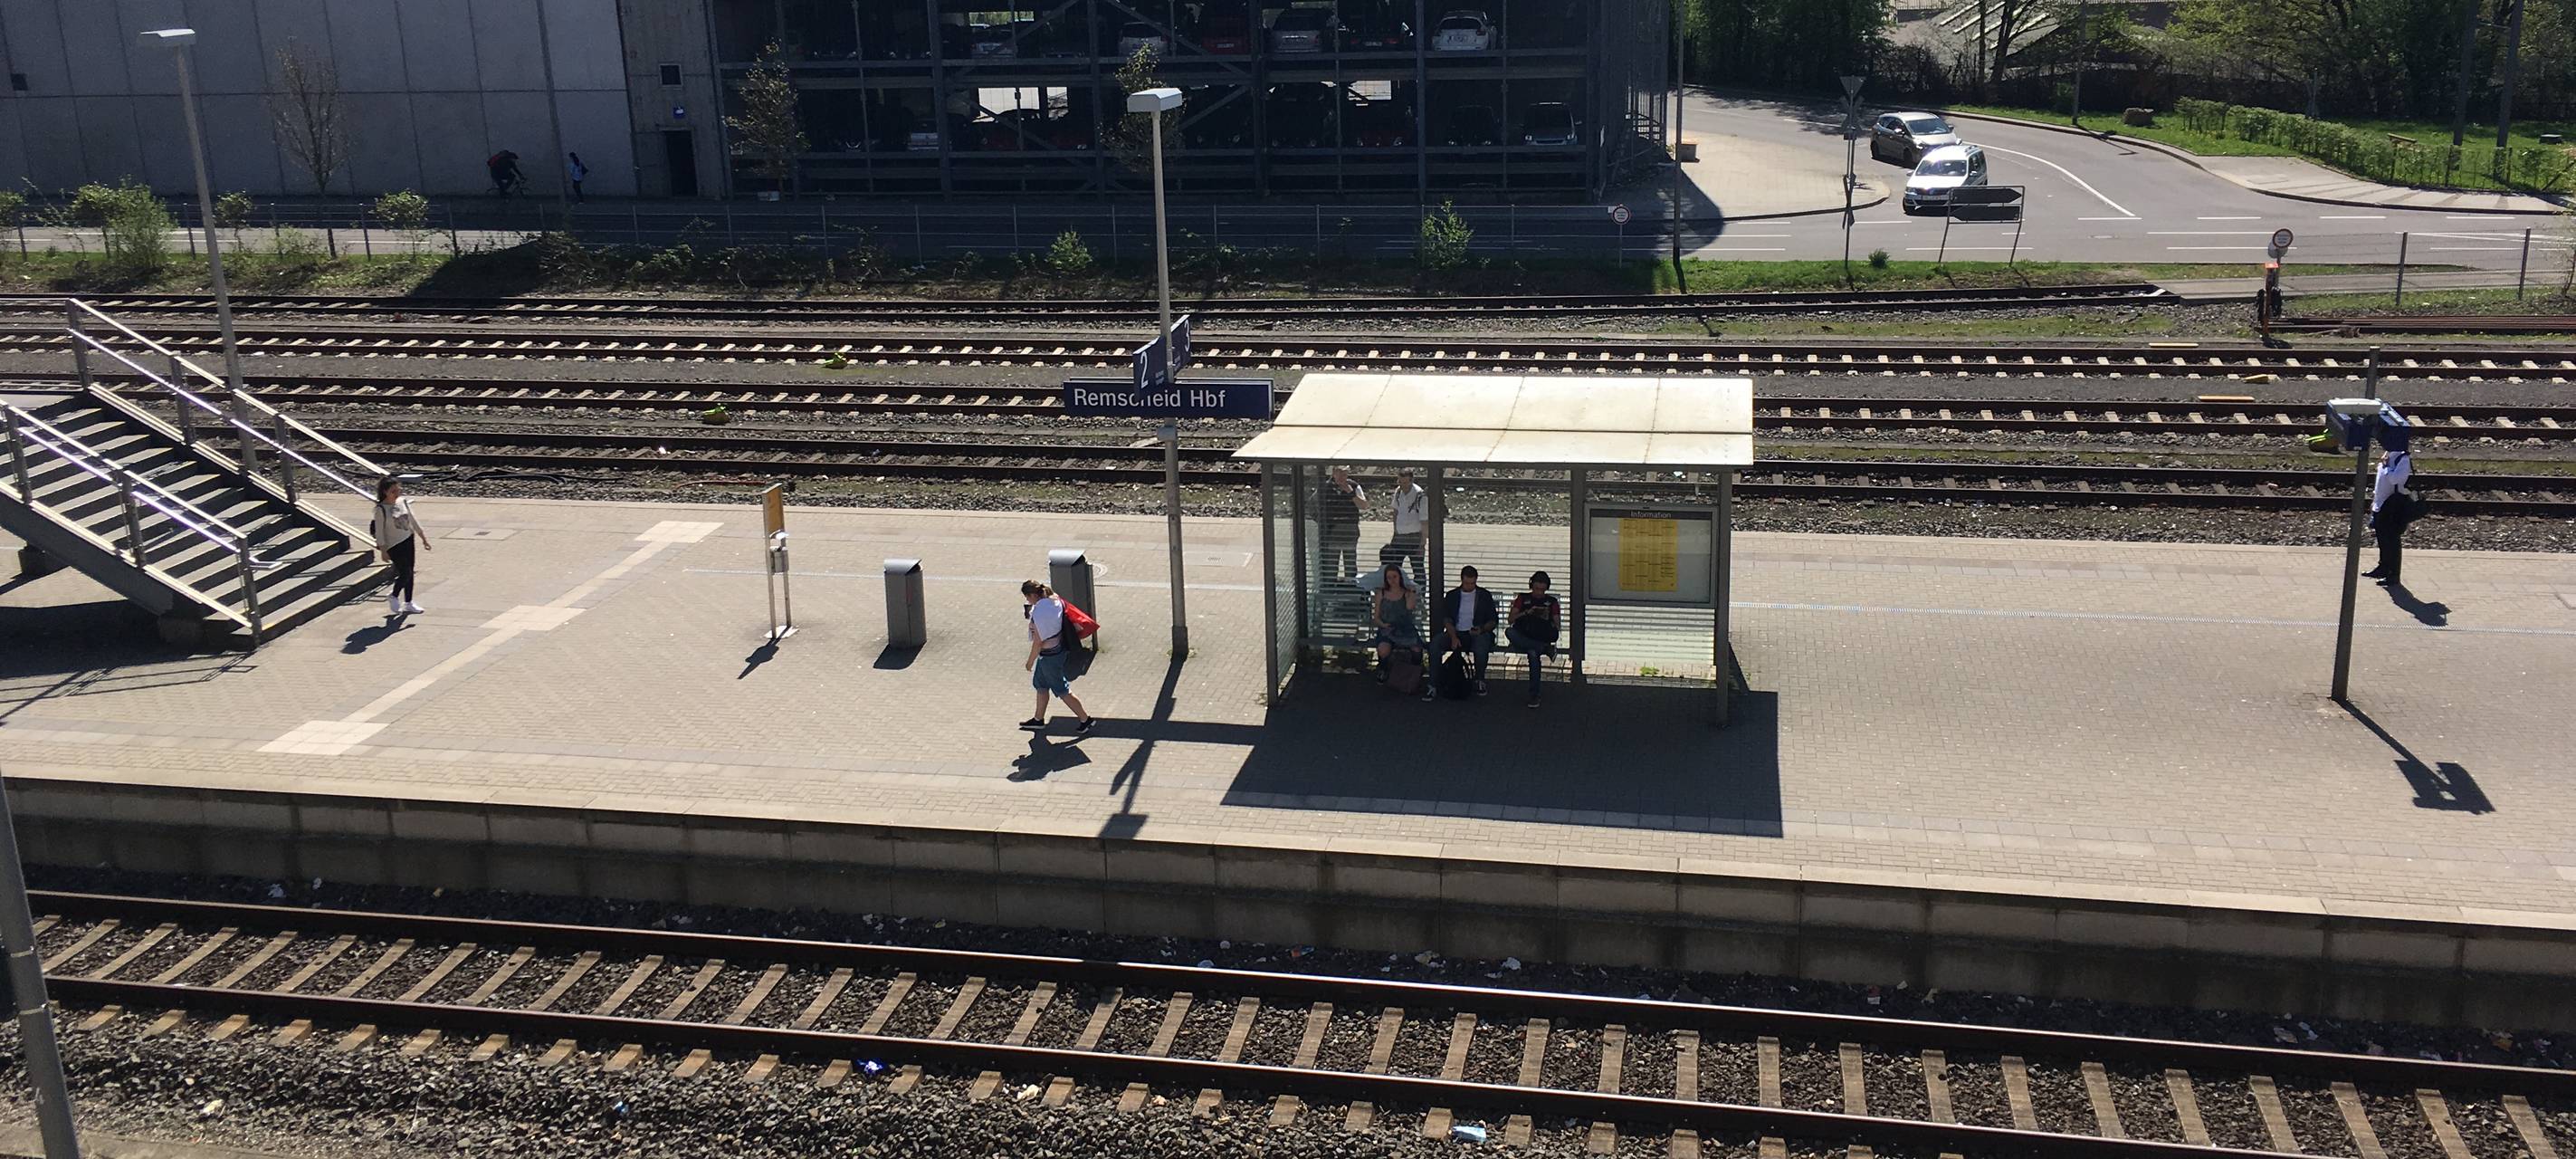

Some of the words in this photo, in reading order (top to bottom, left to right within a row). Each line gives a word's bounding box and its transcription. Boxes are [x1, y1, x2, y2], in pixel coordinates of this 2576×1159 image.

[1184, 319, 1190, 352] 3
[1140, 350, 1149, 388] 2
[1190, 389, 1226, 407] Hbf
